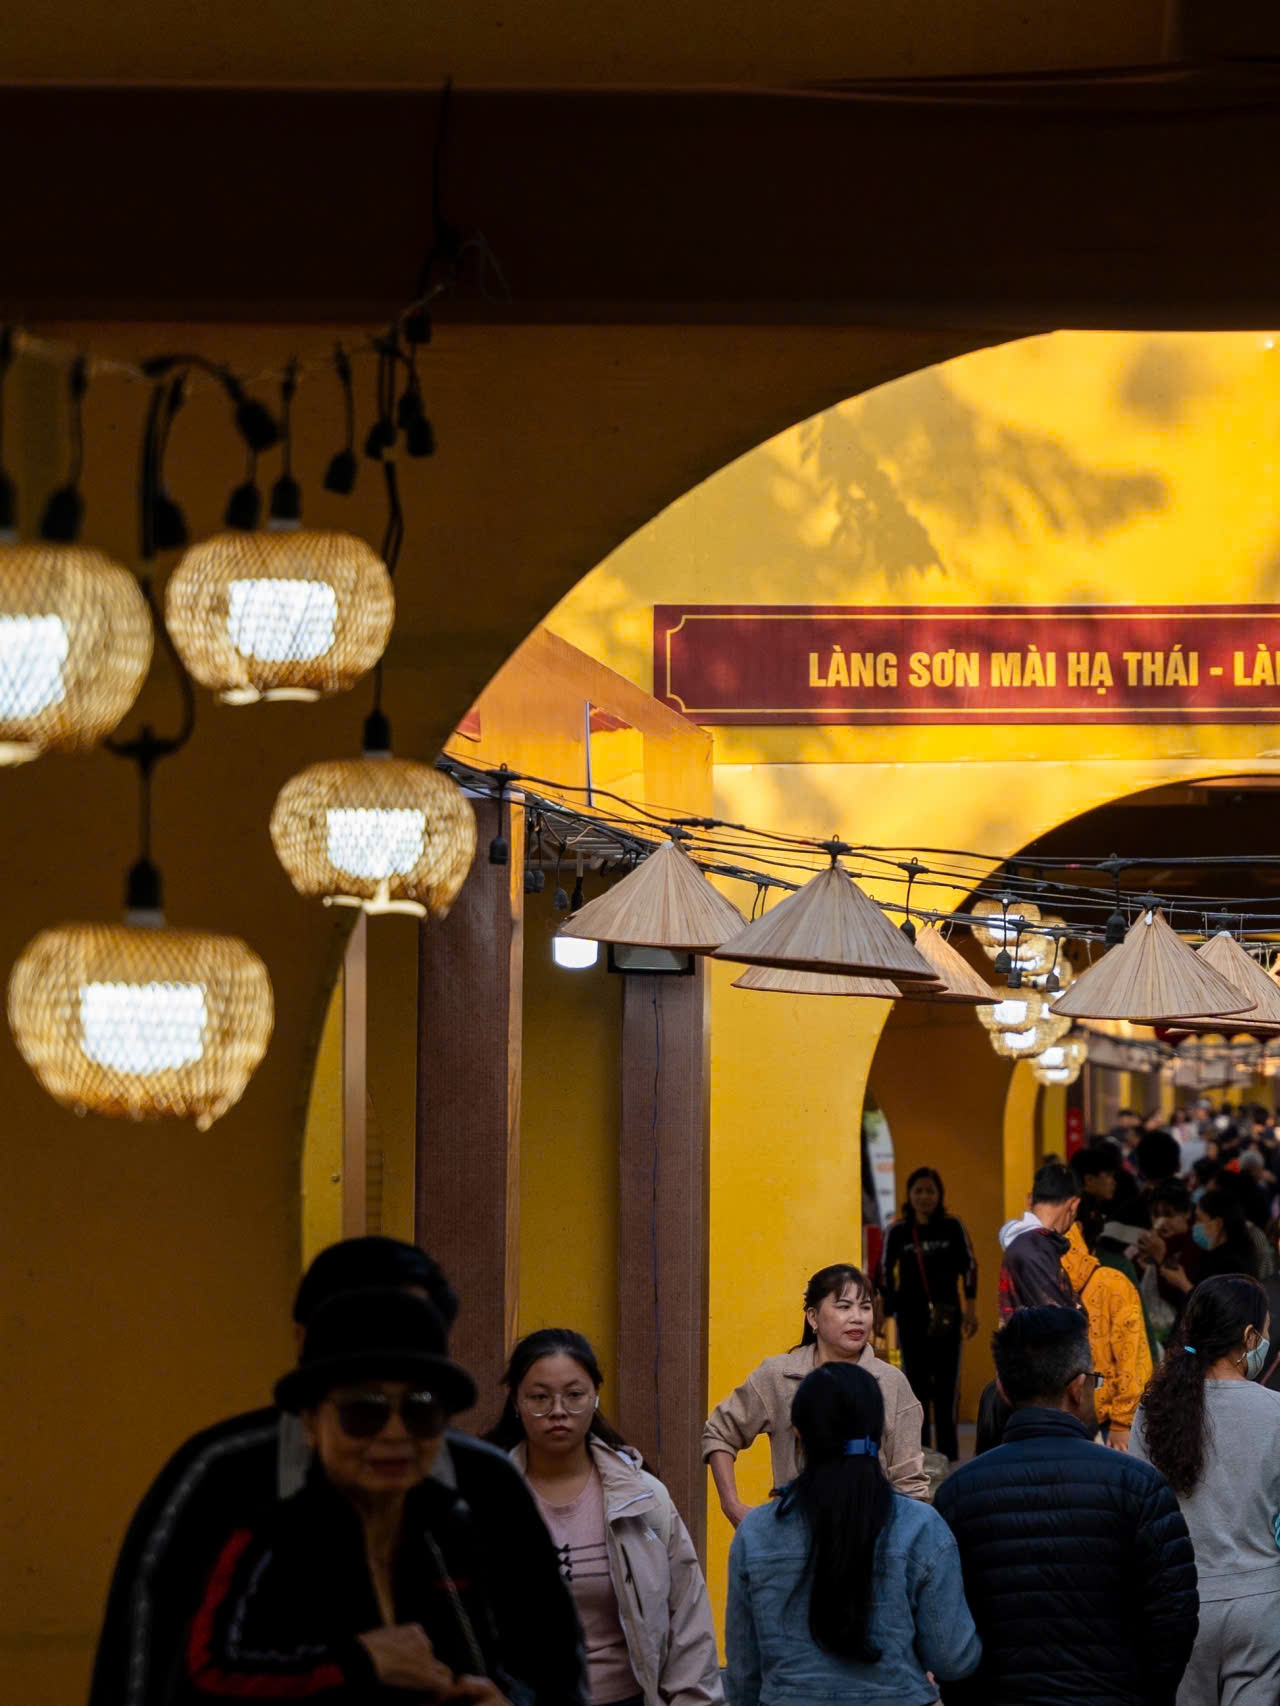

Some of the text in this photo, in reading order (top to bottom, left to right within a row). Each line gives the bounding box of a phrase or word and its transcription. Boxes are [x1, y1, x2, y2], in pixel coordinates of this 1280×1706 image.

[808, 644, 898, 688] LÀNG
[908, 648, 981, 689] SƠN
[990, 643, 1057, 688] MÀI
[1067, 651, 1114, 695] HẠ
[1122, 643, 1199, 687] THÁI
[1209, 666, 1224, 676] -
